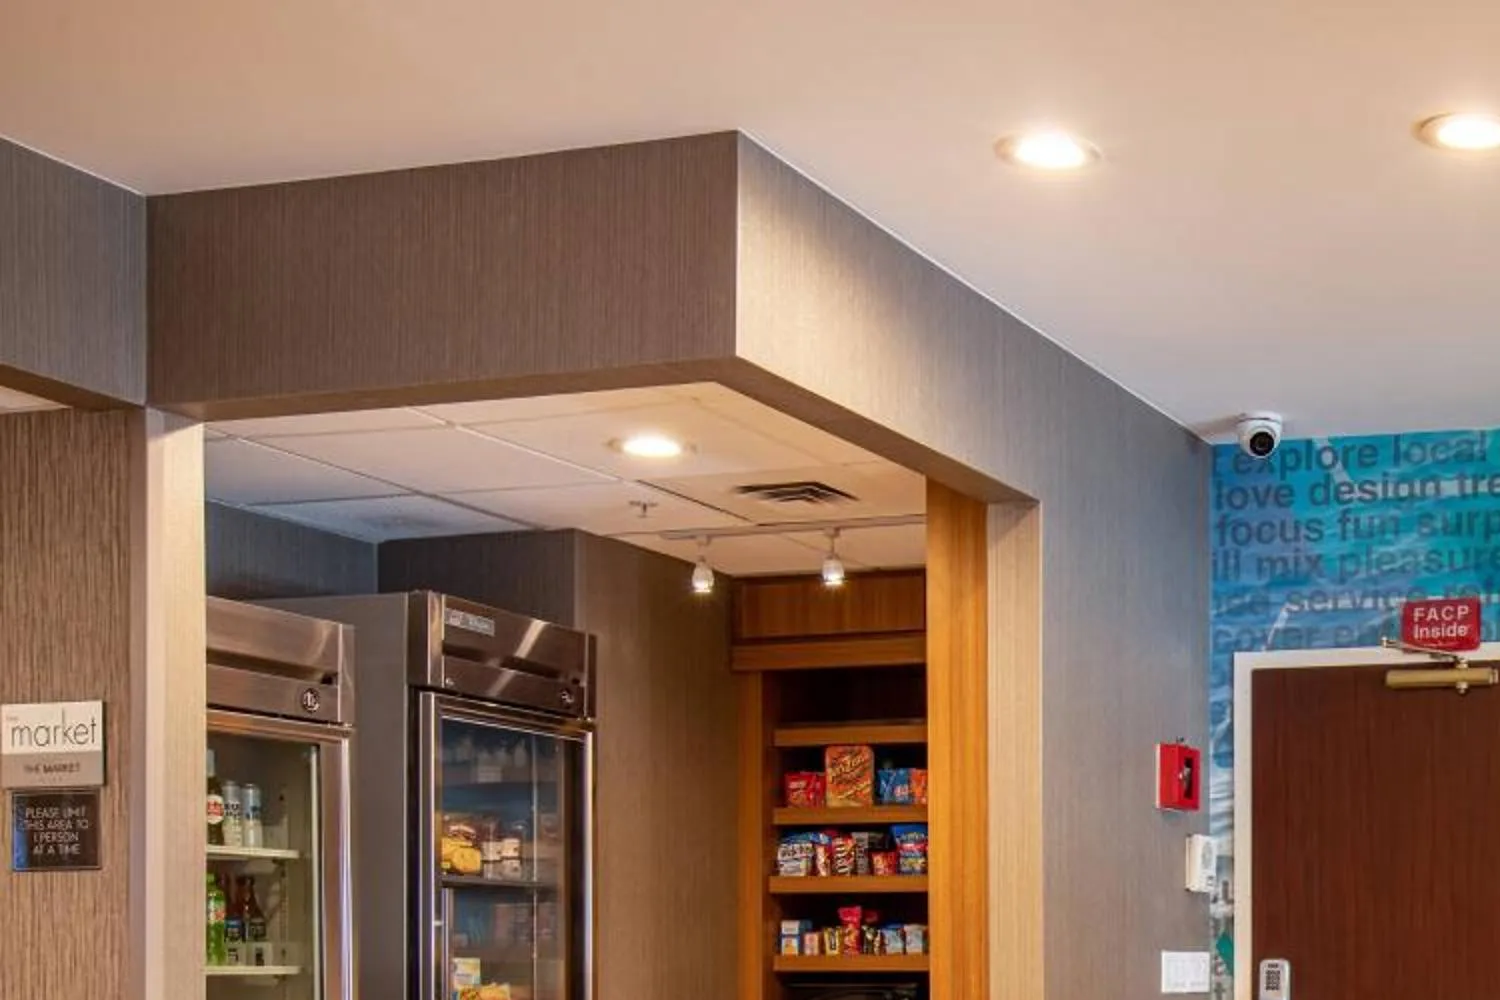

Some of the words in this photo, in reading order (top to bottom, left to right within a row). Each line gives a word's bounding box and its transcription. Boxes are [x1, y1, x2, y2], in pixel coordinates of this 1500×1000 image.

[1231, 439, 1379, 481] explore
[1393, 431, 1487, 466] local
[1215, 480, 1296, 511] love
[1310, 471, 1441, 507] design
[1216, 512, 1325, 547] focus
[1338, 508, 1400, 542] fun
[1256, 549, 1324, 581] mix
[1412, 604, 1470, 623] FACP
[1413, 624, 1468, 640] Inside
[11, 707, 97, 747] market
[26, 807, 60, 819] PLEASE
[39, 831, 79, 843] PERSON
